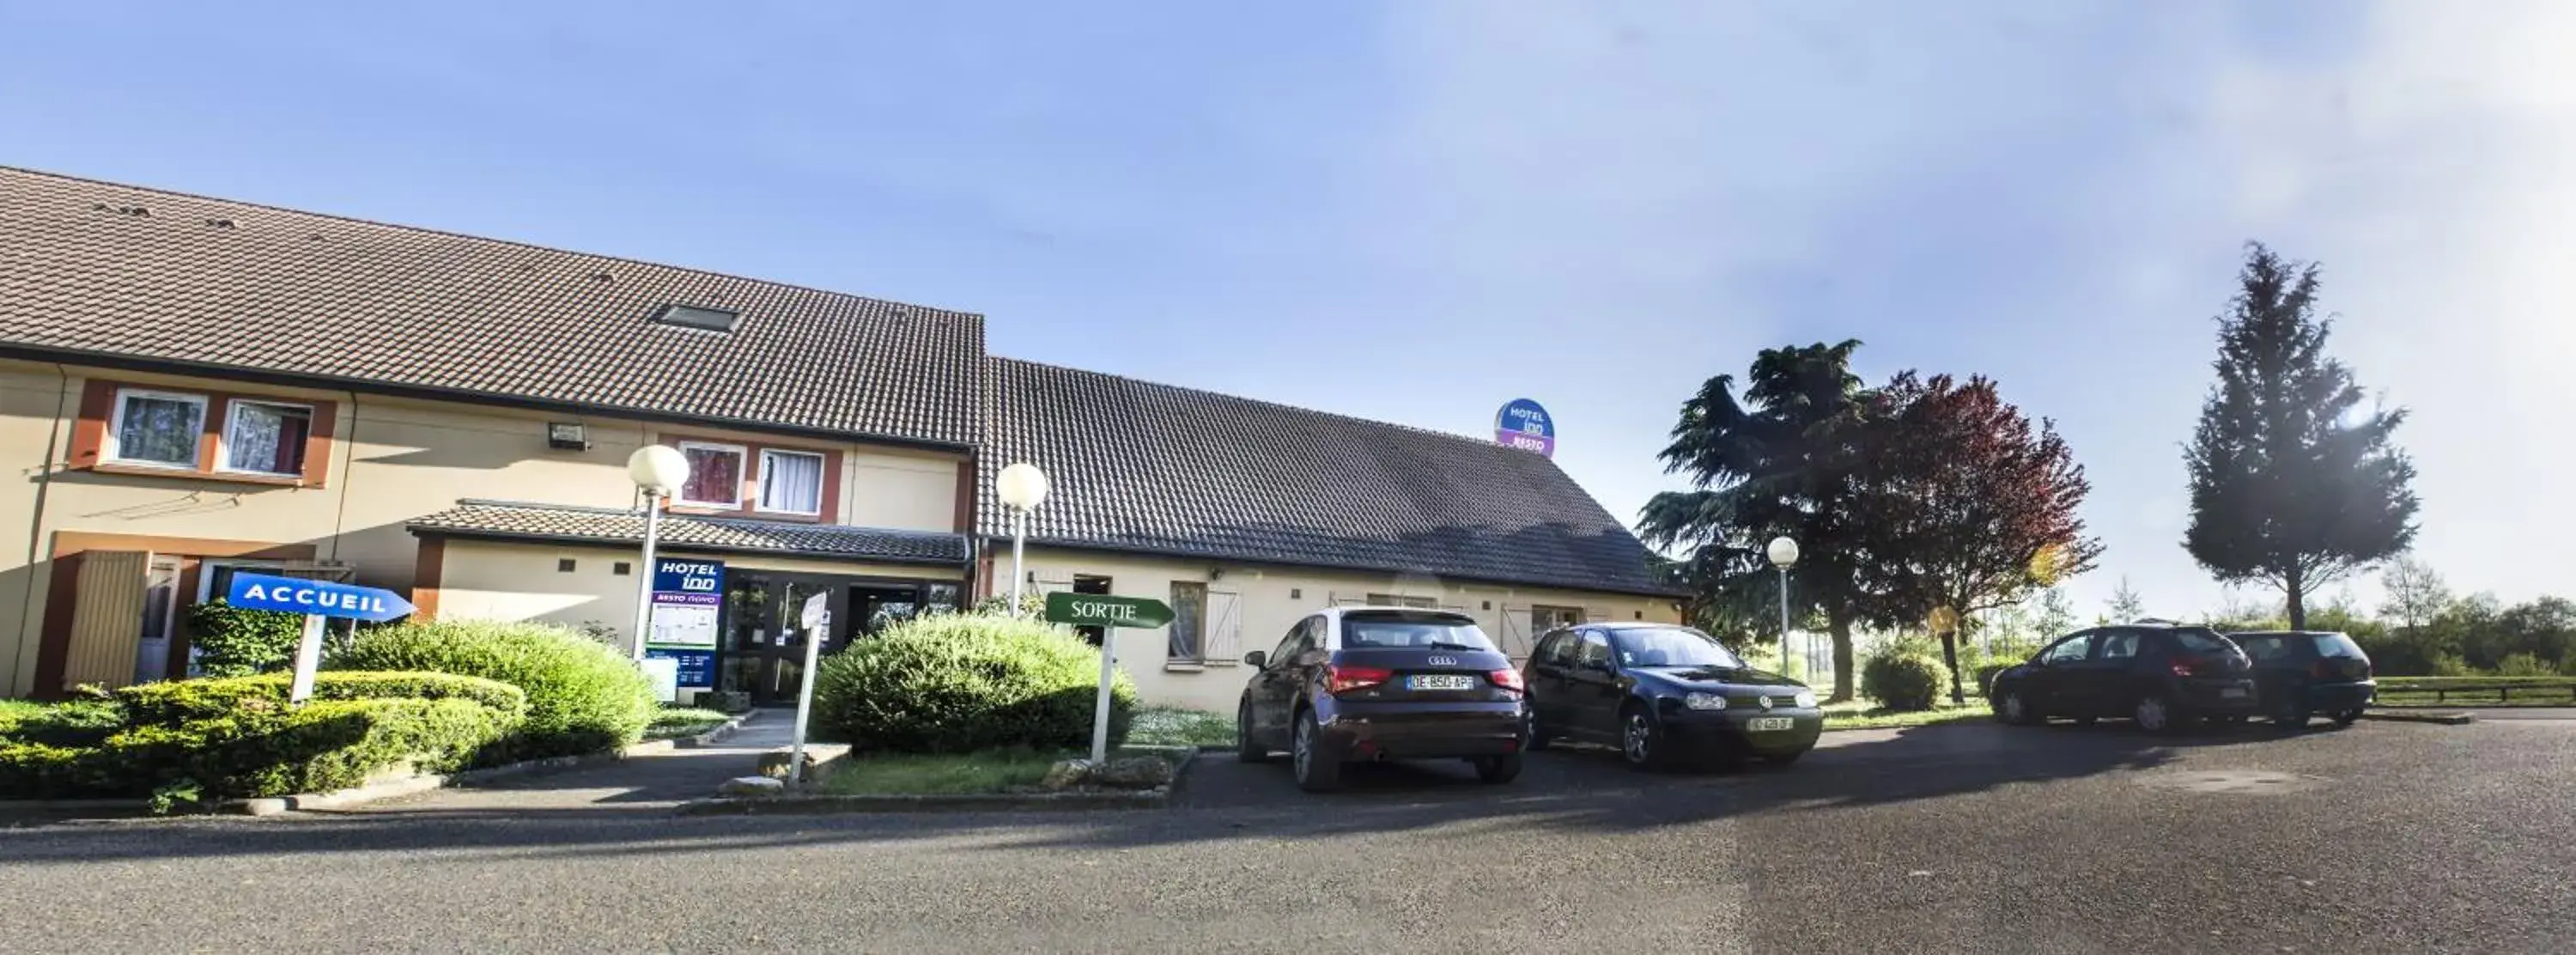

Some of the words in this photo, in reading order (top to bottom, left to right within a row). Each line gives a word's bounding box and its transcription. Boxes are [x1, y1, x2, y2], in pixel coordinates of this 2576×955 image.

[1510, 406, 1544, 422] HOTEL
[1514, 435, 1545, 450] RESTO
[660, 563, 717, 576] HOTEL
[682, 574, 715, 591] inn
[243, 584, 386, 612] ACCUEIL
[1071, 601, 1137, 620] SORTIE
